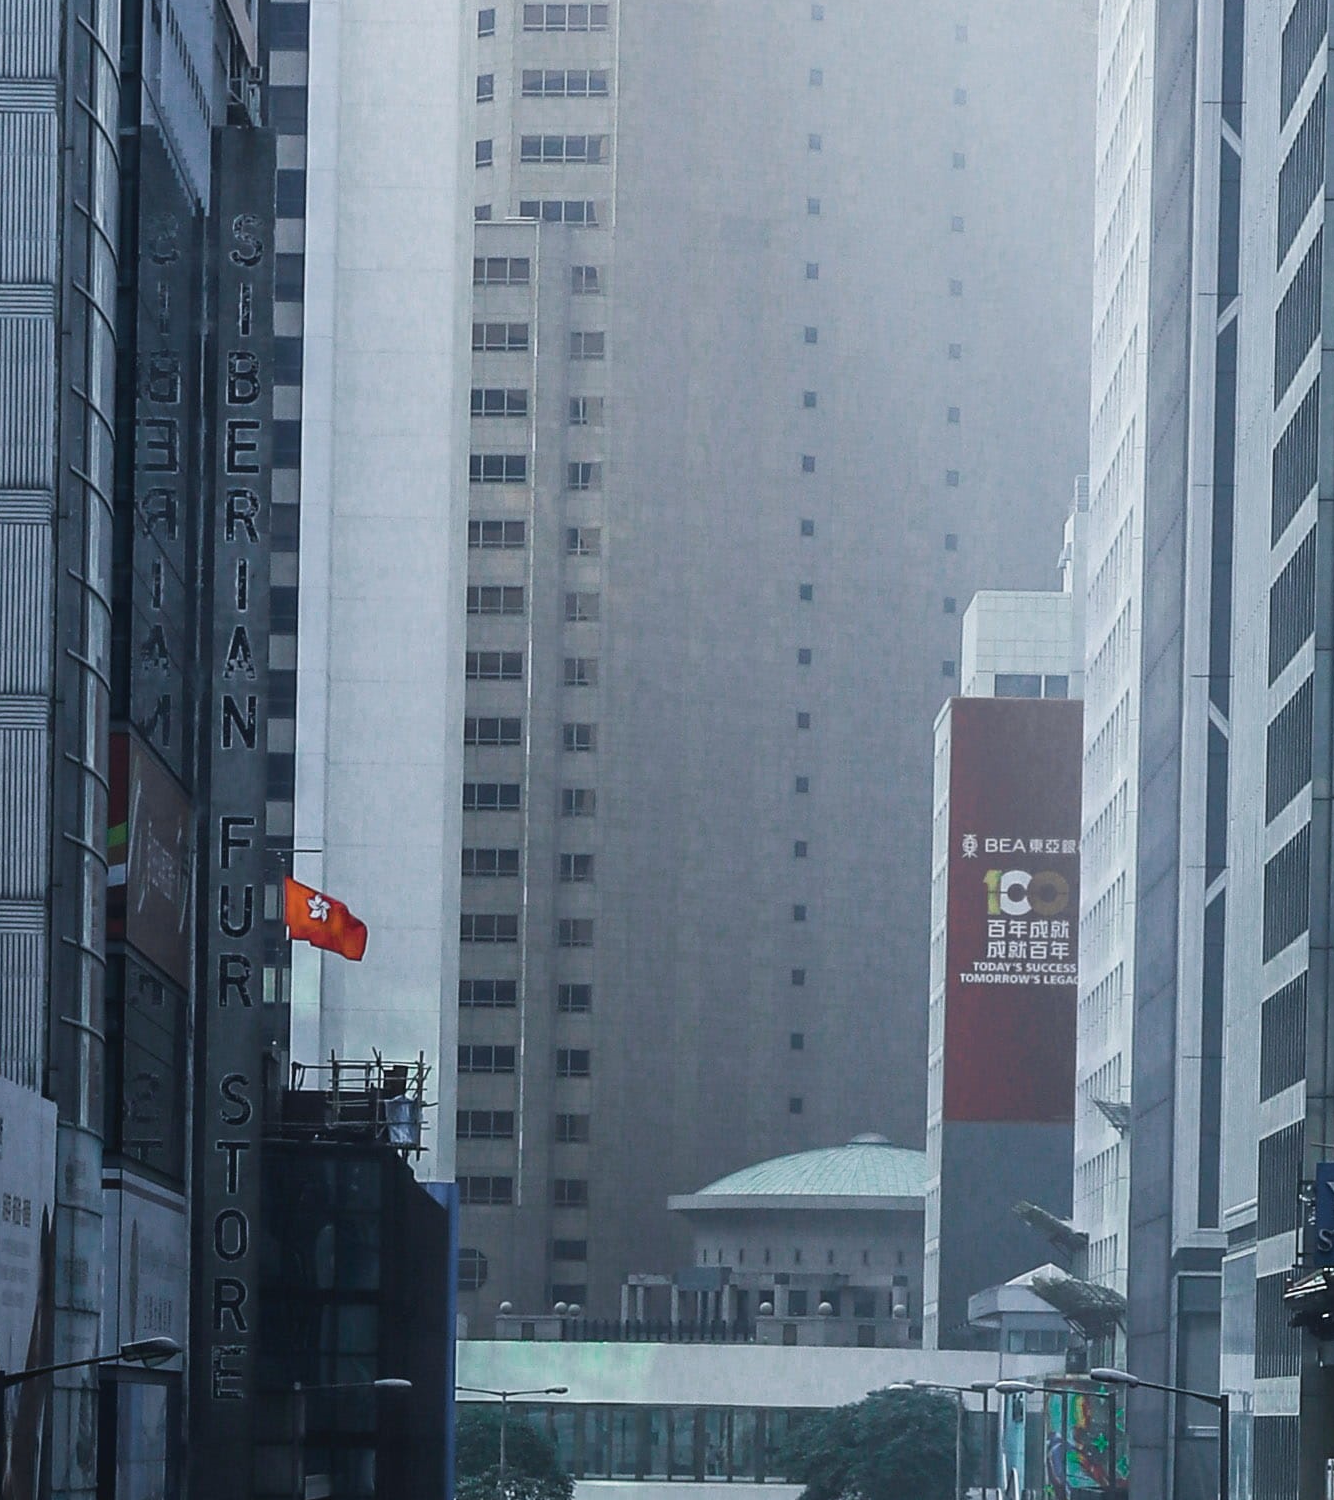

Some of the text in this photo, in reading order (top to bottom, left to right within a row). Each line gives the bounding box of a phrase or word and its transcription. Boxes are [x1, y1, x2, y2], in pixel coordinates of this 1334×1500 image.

[211, 212, 266, 1400] SIBERIAN FUR STORE
[985, 838, 1080, 854] BEA 東亞銀
[987, 919, 1070, 939] 百年成就
[987, 940, 1070, 960] 成就百年
[973, 961, 1077, 973] TODAY'S SUCCESS
[959, 973, 1041, 985] TOMORROW'S
